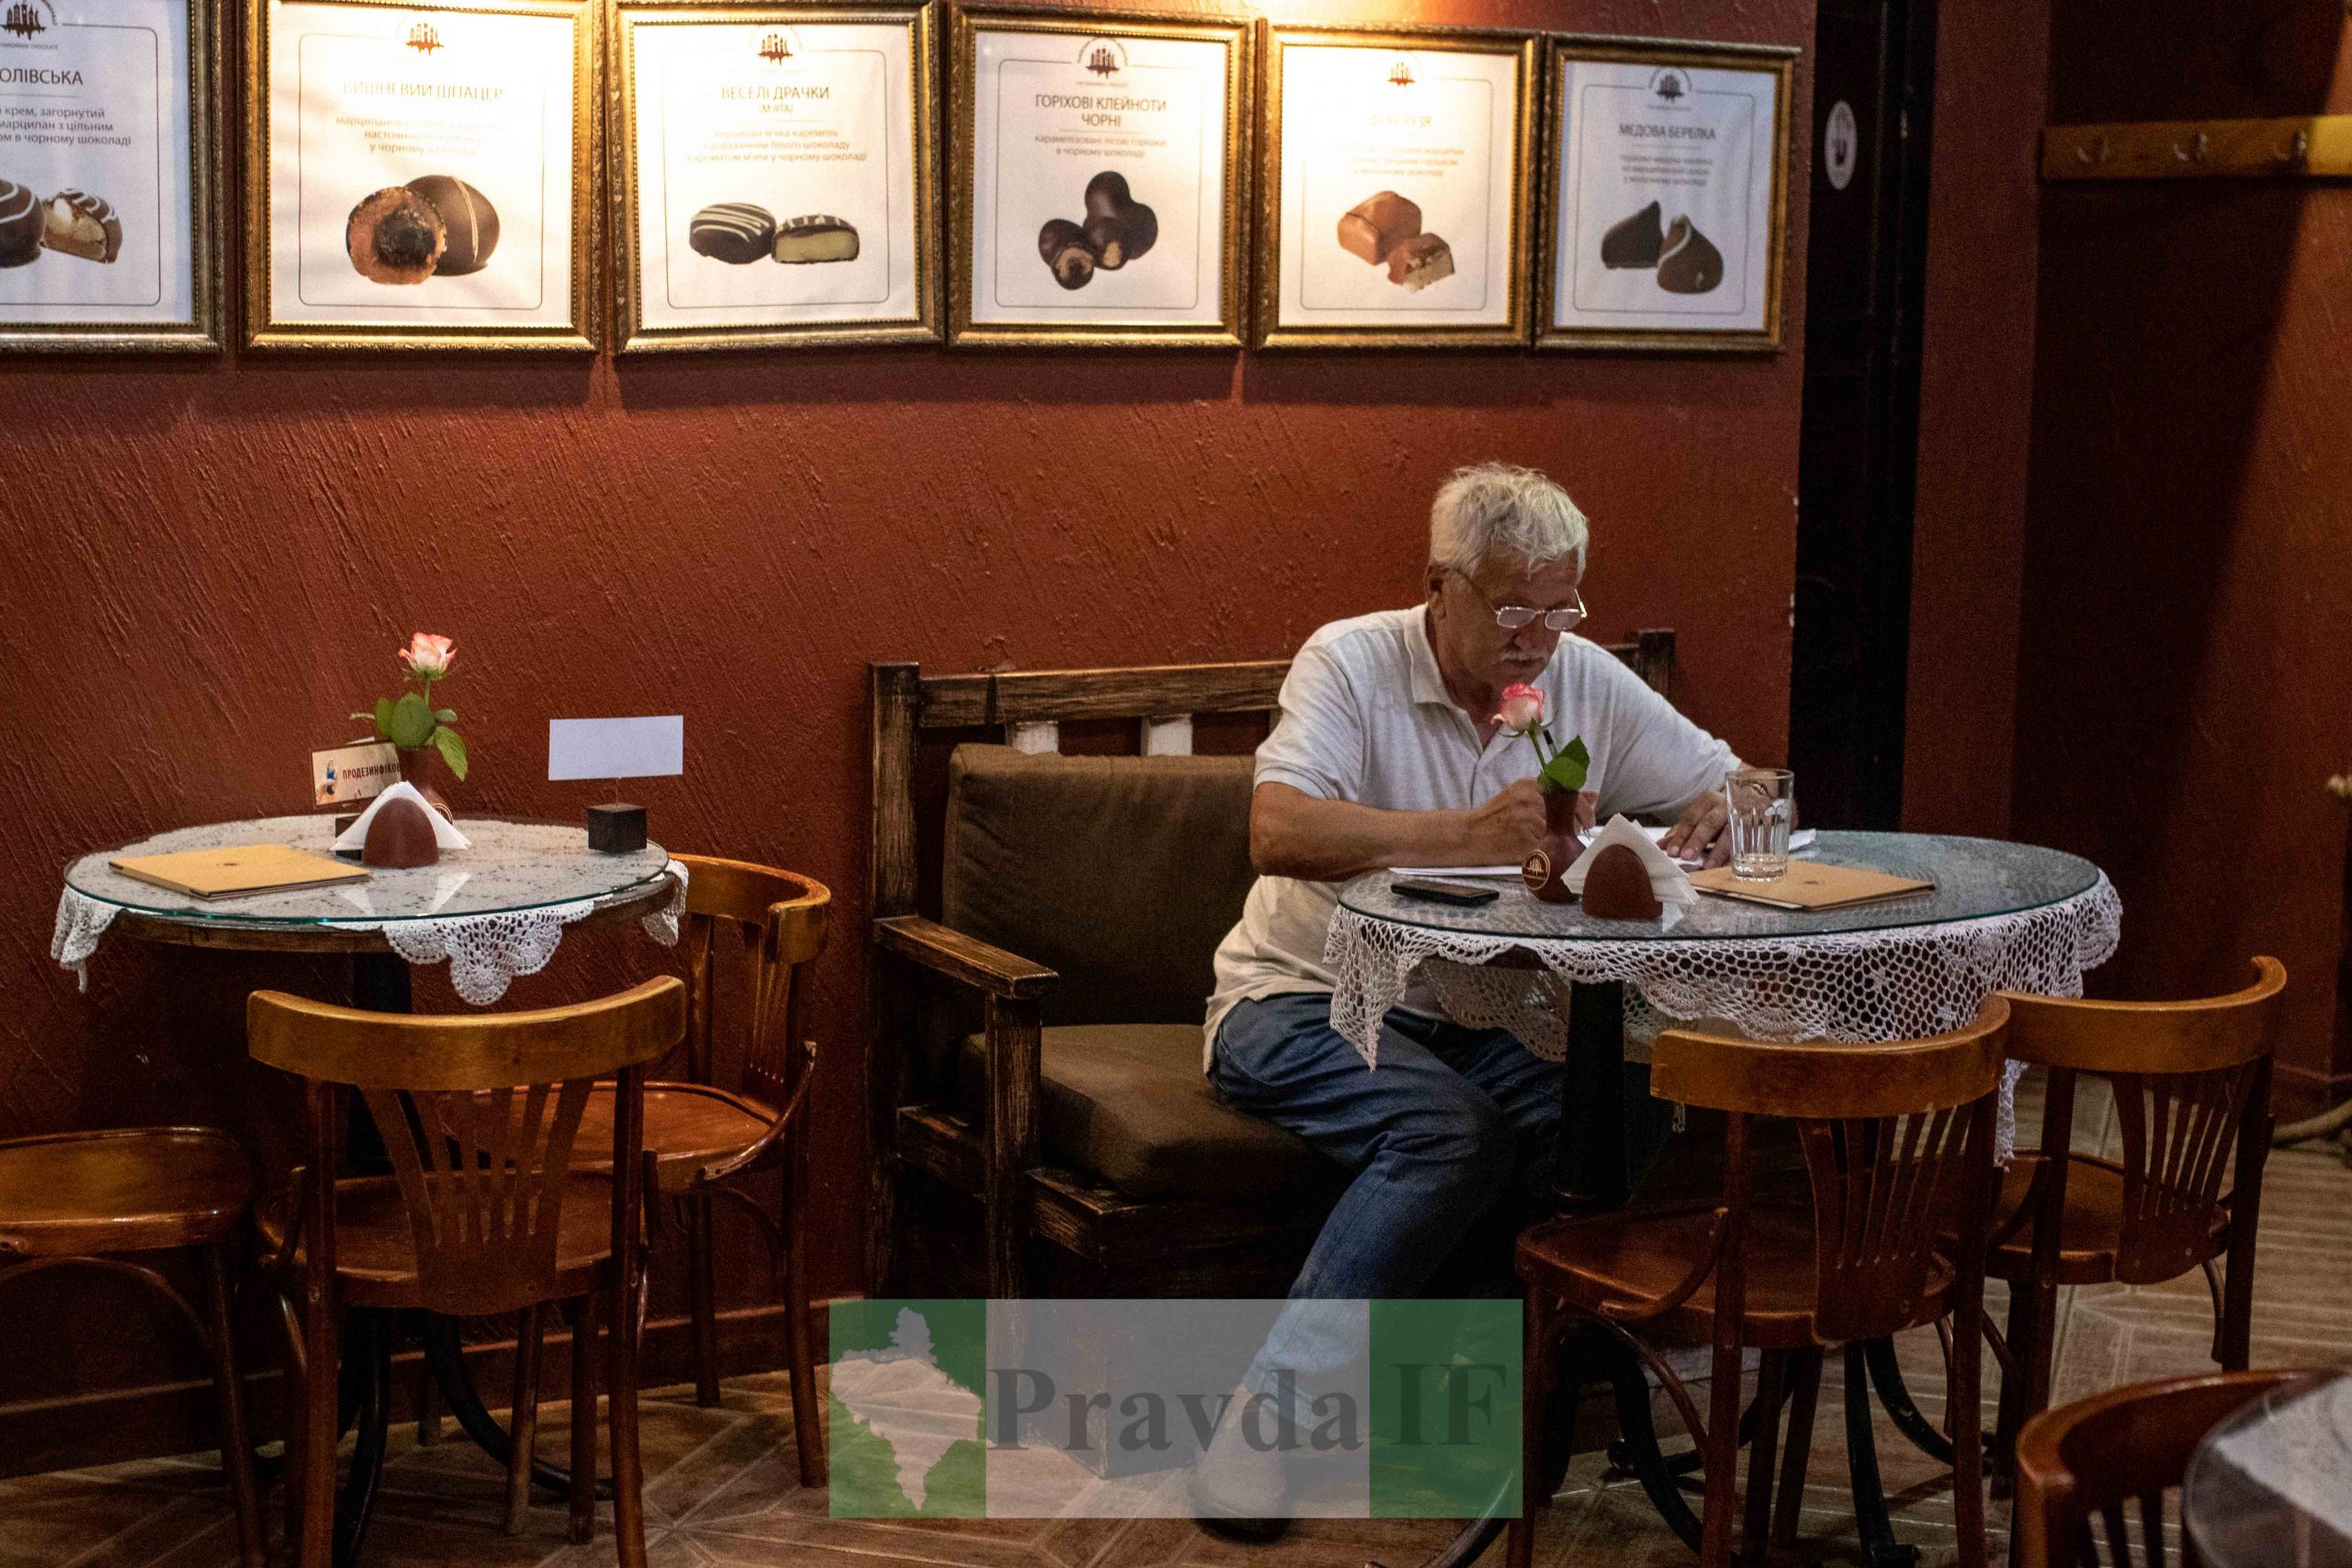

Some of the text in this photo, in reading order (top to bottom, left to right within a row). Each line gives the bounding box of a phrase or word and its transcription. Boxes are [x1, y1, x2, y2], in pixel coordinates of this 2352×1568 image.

[721, 86, 830, 100] ВЕСЕЛІ ДРАЧКИ
[1035, 94, 1093, 109] ГОРІХОВІ
[5, 107, 105, 118] крем, загорнутий
[67, 121, 113, 131] цільним
[1081, 113, 1122, 128] ЧОРНІ
[24, 134, 74, 146] чорному
[78, 135, 131, 147] шоколаді
